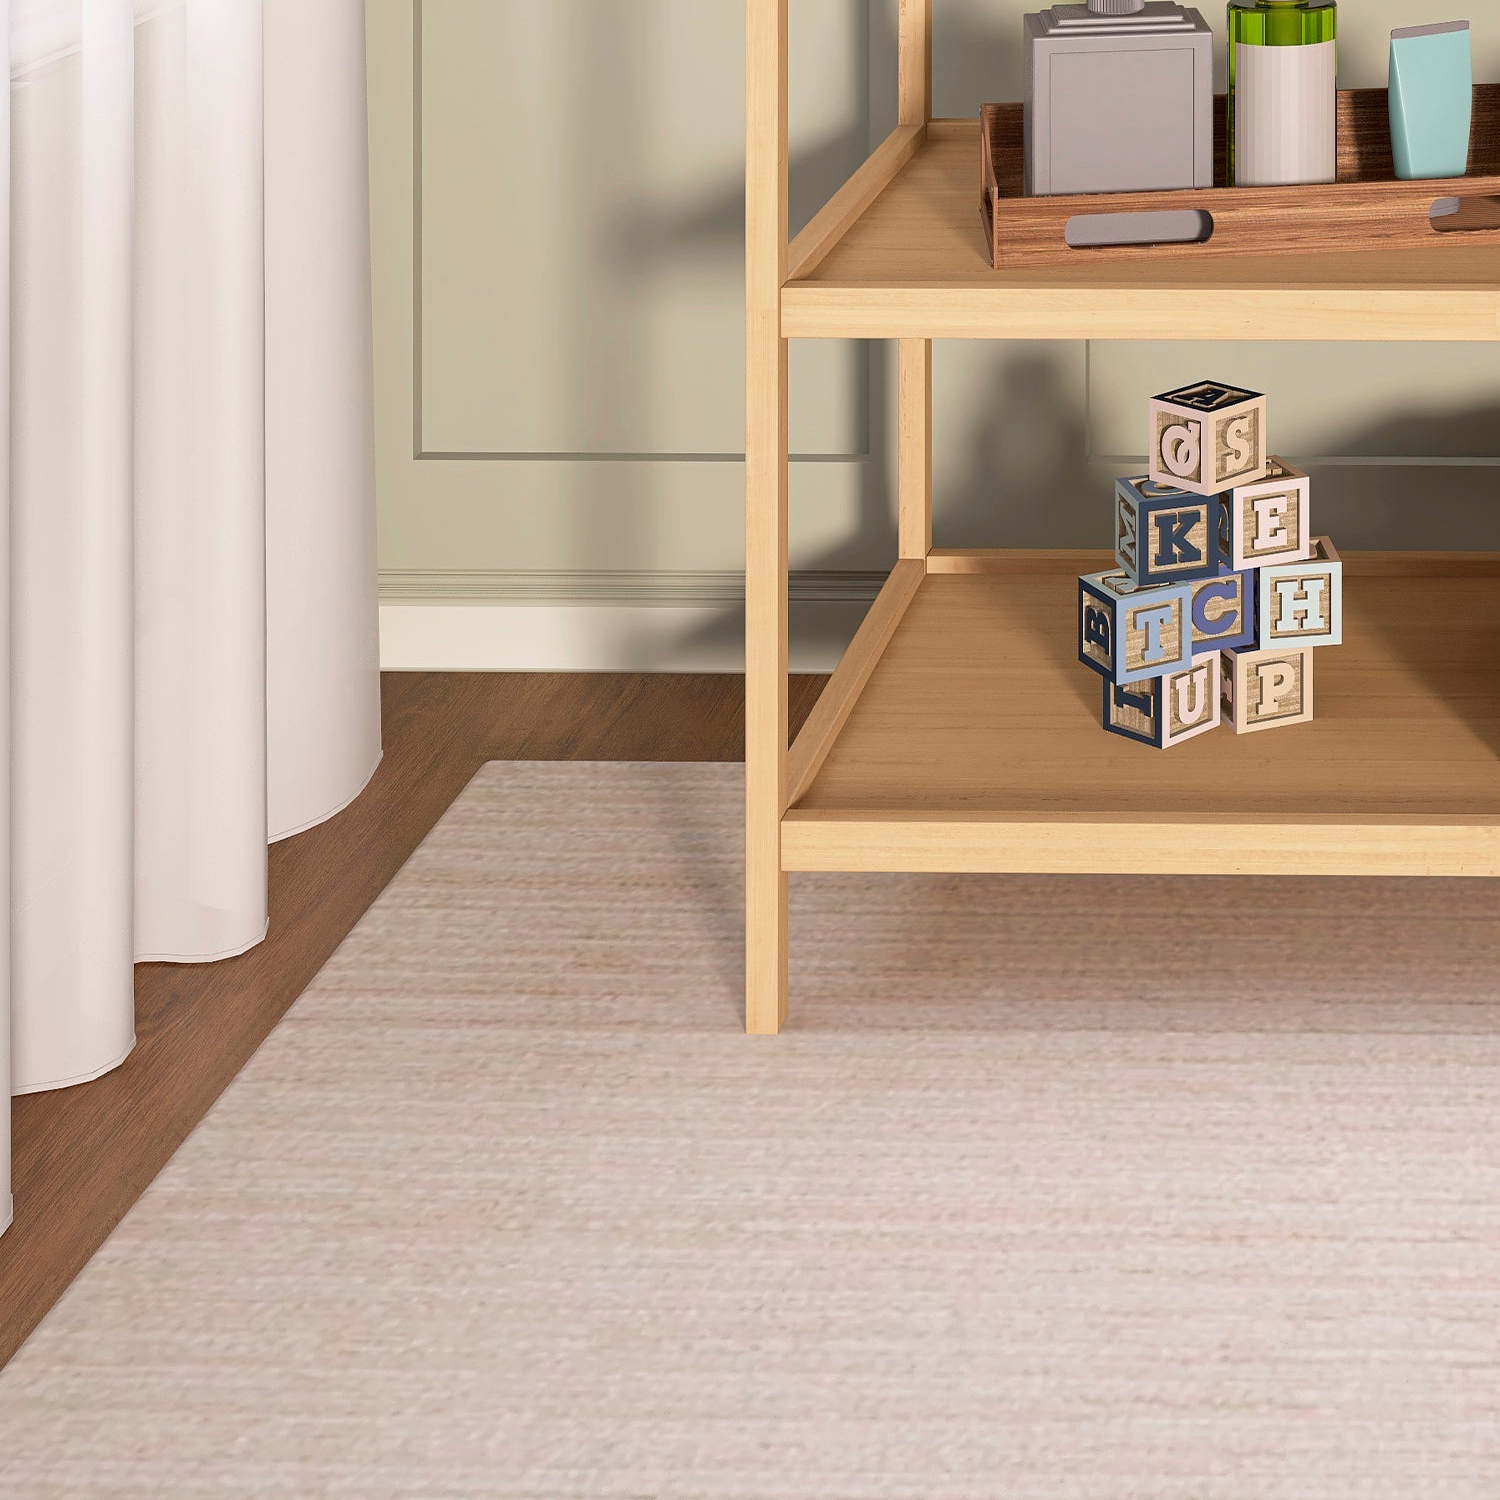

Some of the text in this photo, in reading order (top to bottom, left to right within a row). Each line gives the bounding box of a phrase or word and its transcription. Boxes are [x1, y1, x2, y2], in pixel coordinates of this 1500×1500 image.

[1224, 416, 1250, 473] S
[1155, 511, 1201, 567] K
[1252, 495, 1288, 550] E
[1192, 580, 1238, 635] C
[1275, 579, 1325, 632] H
[1134, 605, 1172, 662] T
[1174, 667, 1208, 725] U
[1257, 661, 1296, 715] P
